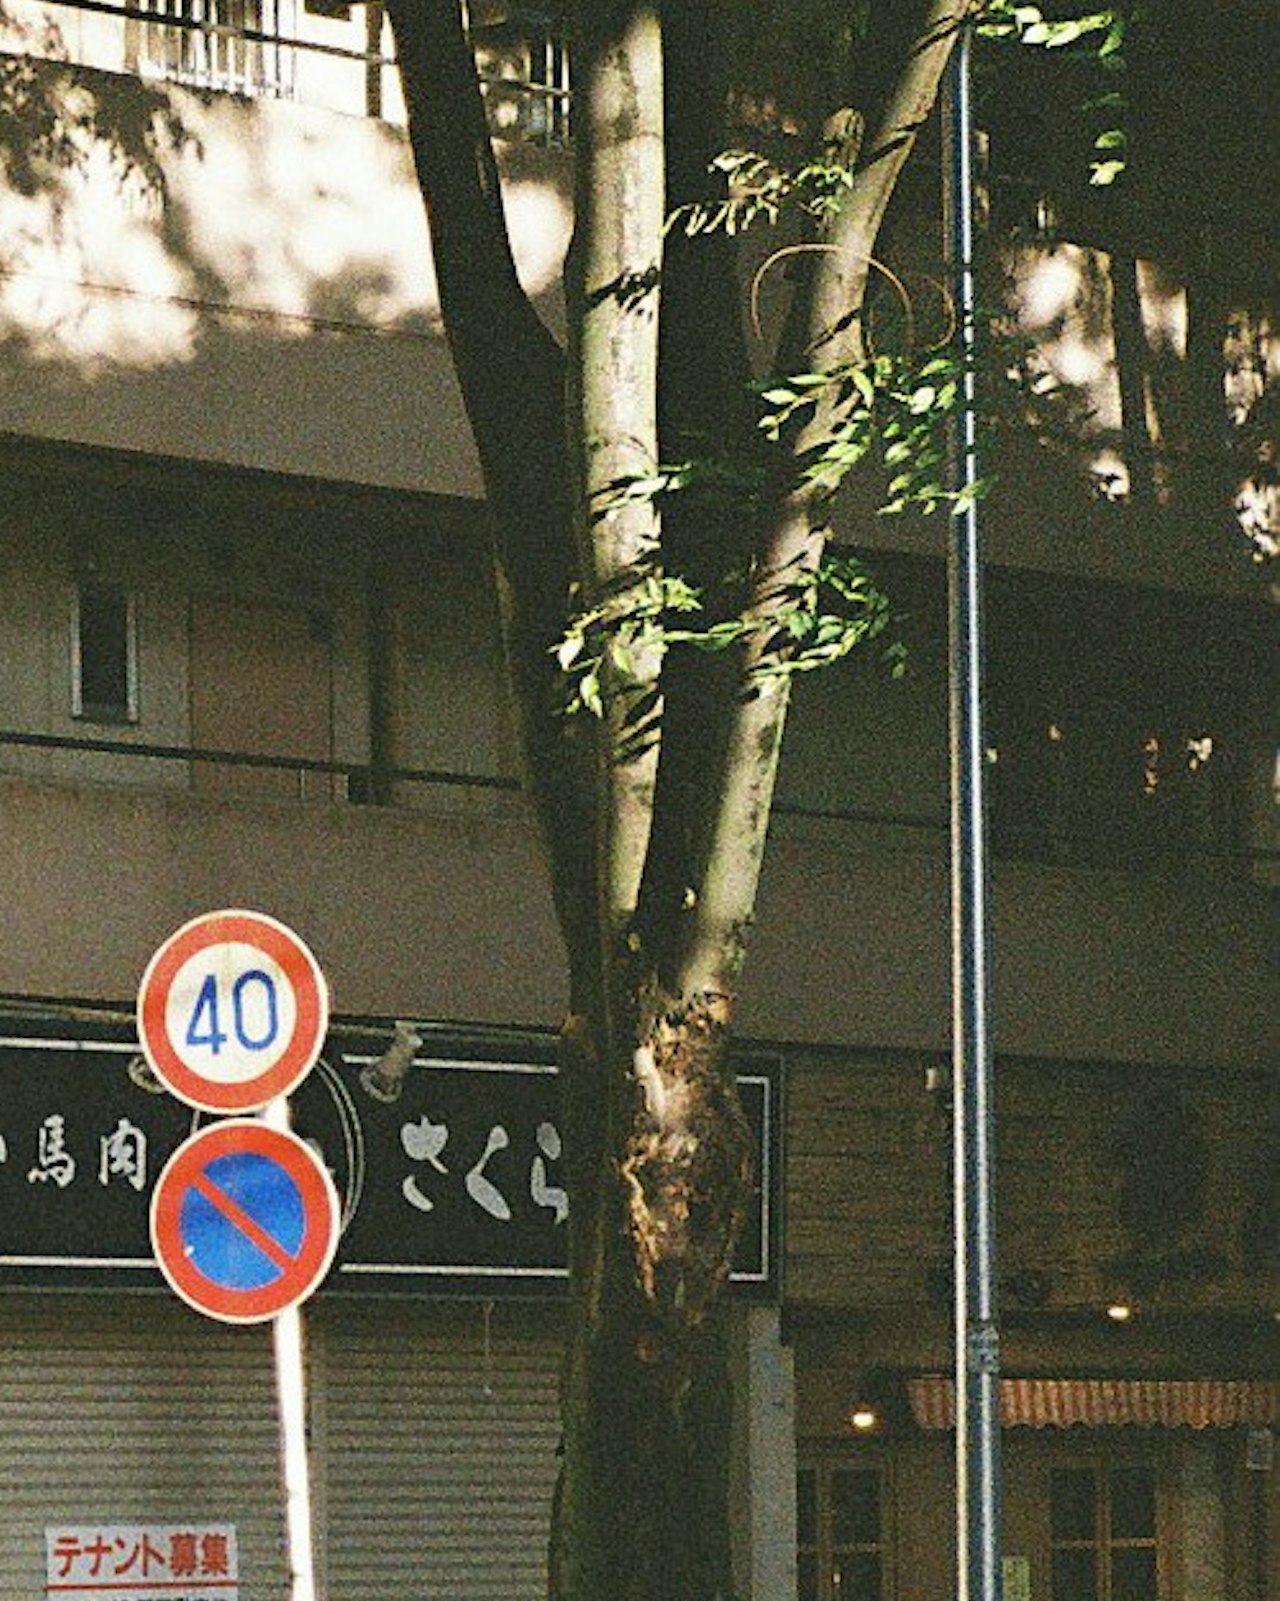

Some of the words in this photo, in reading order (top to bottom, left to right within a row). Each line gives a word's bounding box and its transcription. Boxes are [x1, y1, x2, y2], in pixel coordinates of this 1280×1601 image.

[186, 969, 279, 1054] 40
[401, 1115, 569, 1225] さくら
[54, 1532, 228, 1577] テナント募集
